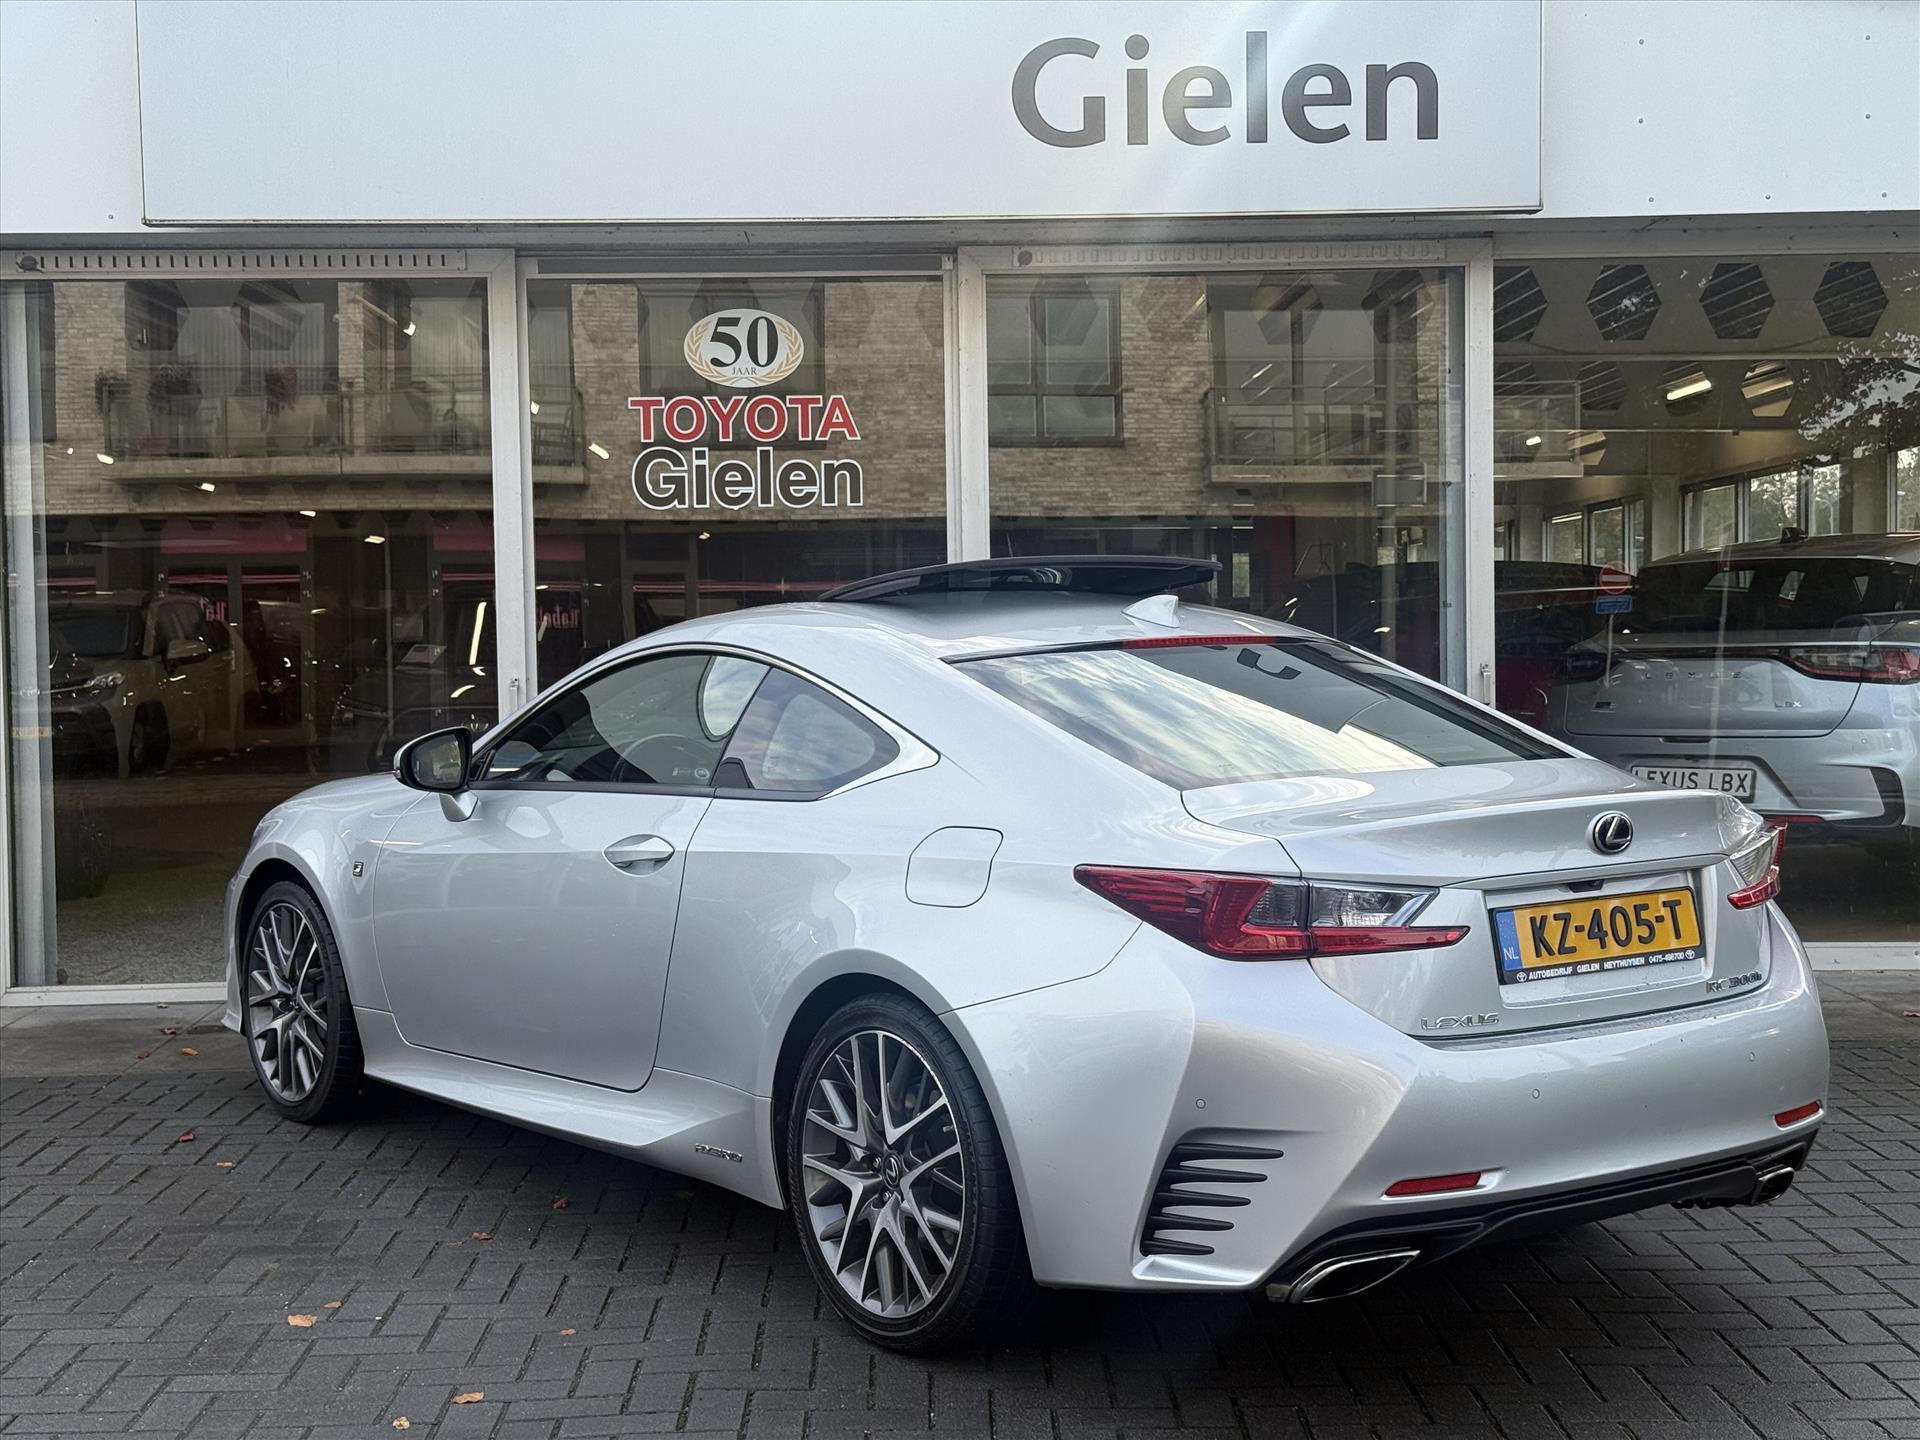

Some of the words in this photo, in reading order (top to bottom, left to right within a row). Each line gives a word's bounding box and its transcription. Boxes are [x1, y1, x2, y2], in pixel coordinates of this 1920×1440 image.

[1011, 30, 1439, 149] Gielen
[710, 315, 779, 368] 50
[731, 366, 758, 376] JAAR
[628, 394, 862, 443] TOYOTA
[632, 446, 864, 510] Gielen
[1708, 772, 1748, 793] LBX
[1528, 899, 1682, 958] KZ-405-T
[1503, 947, 1520, 961] NL
[1528, 966, 1573, 981] AUTOBEDRIJF
[1576, 961, 1600, 974] GIELEN
[1603, 957, 1645, 970] HEYTHUYSEN
[1706, 979, 1728, 994] RC
[1420, 1012, 1500, 1031] LEXUS
